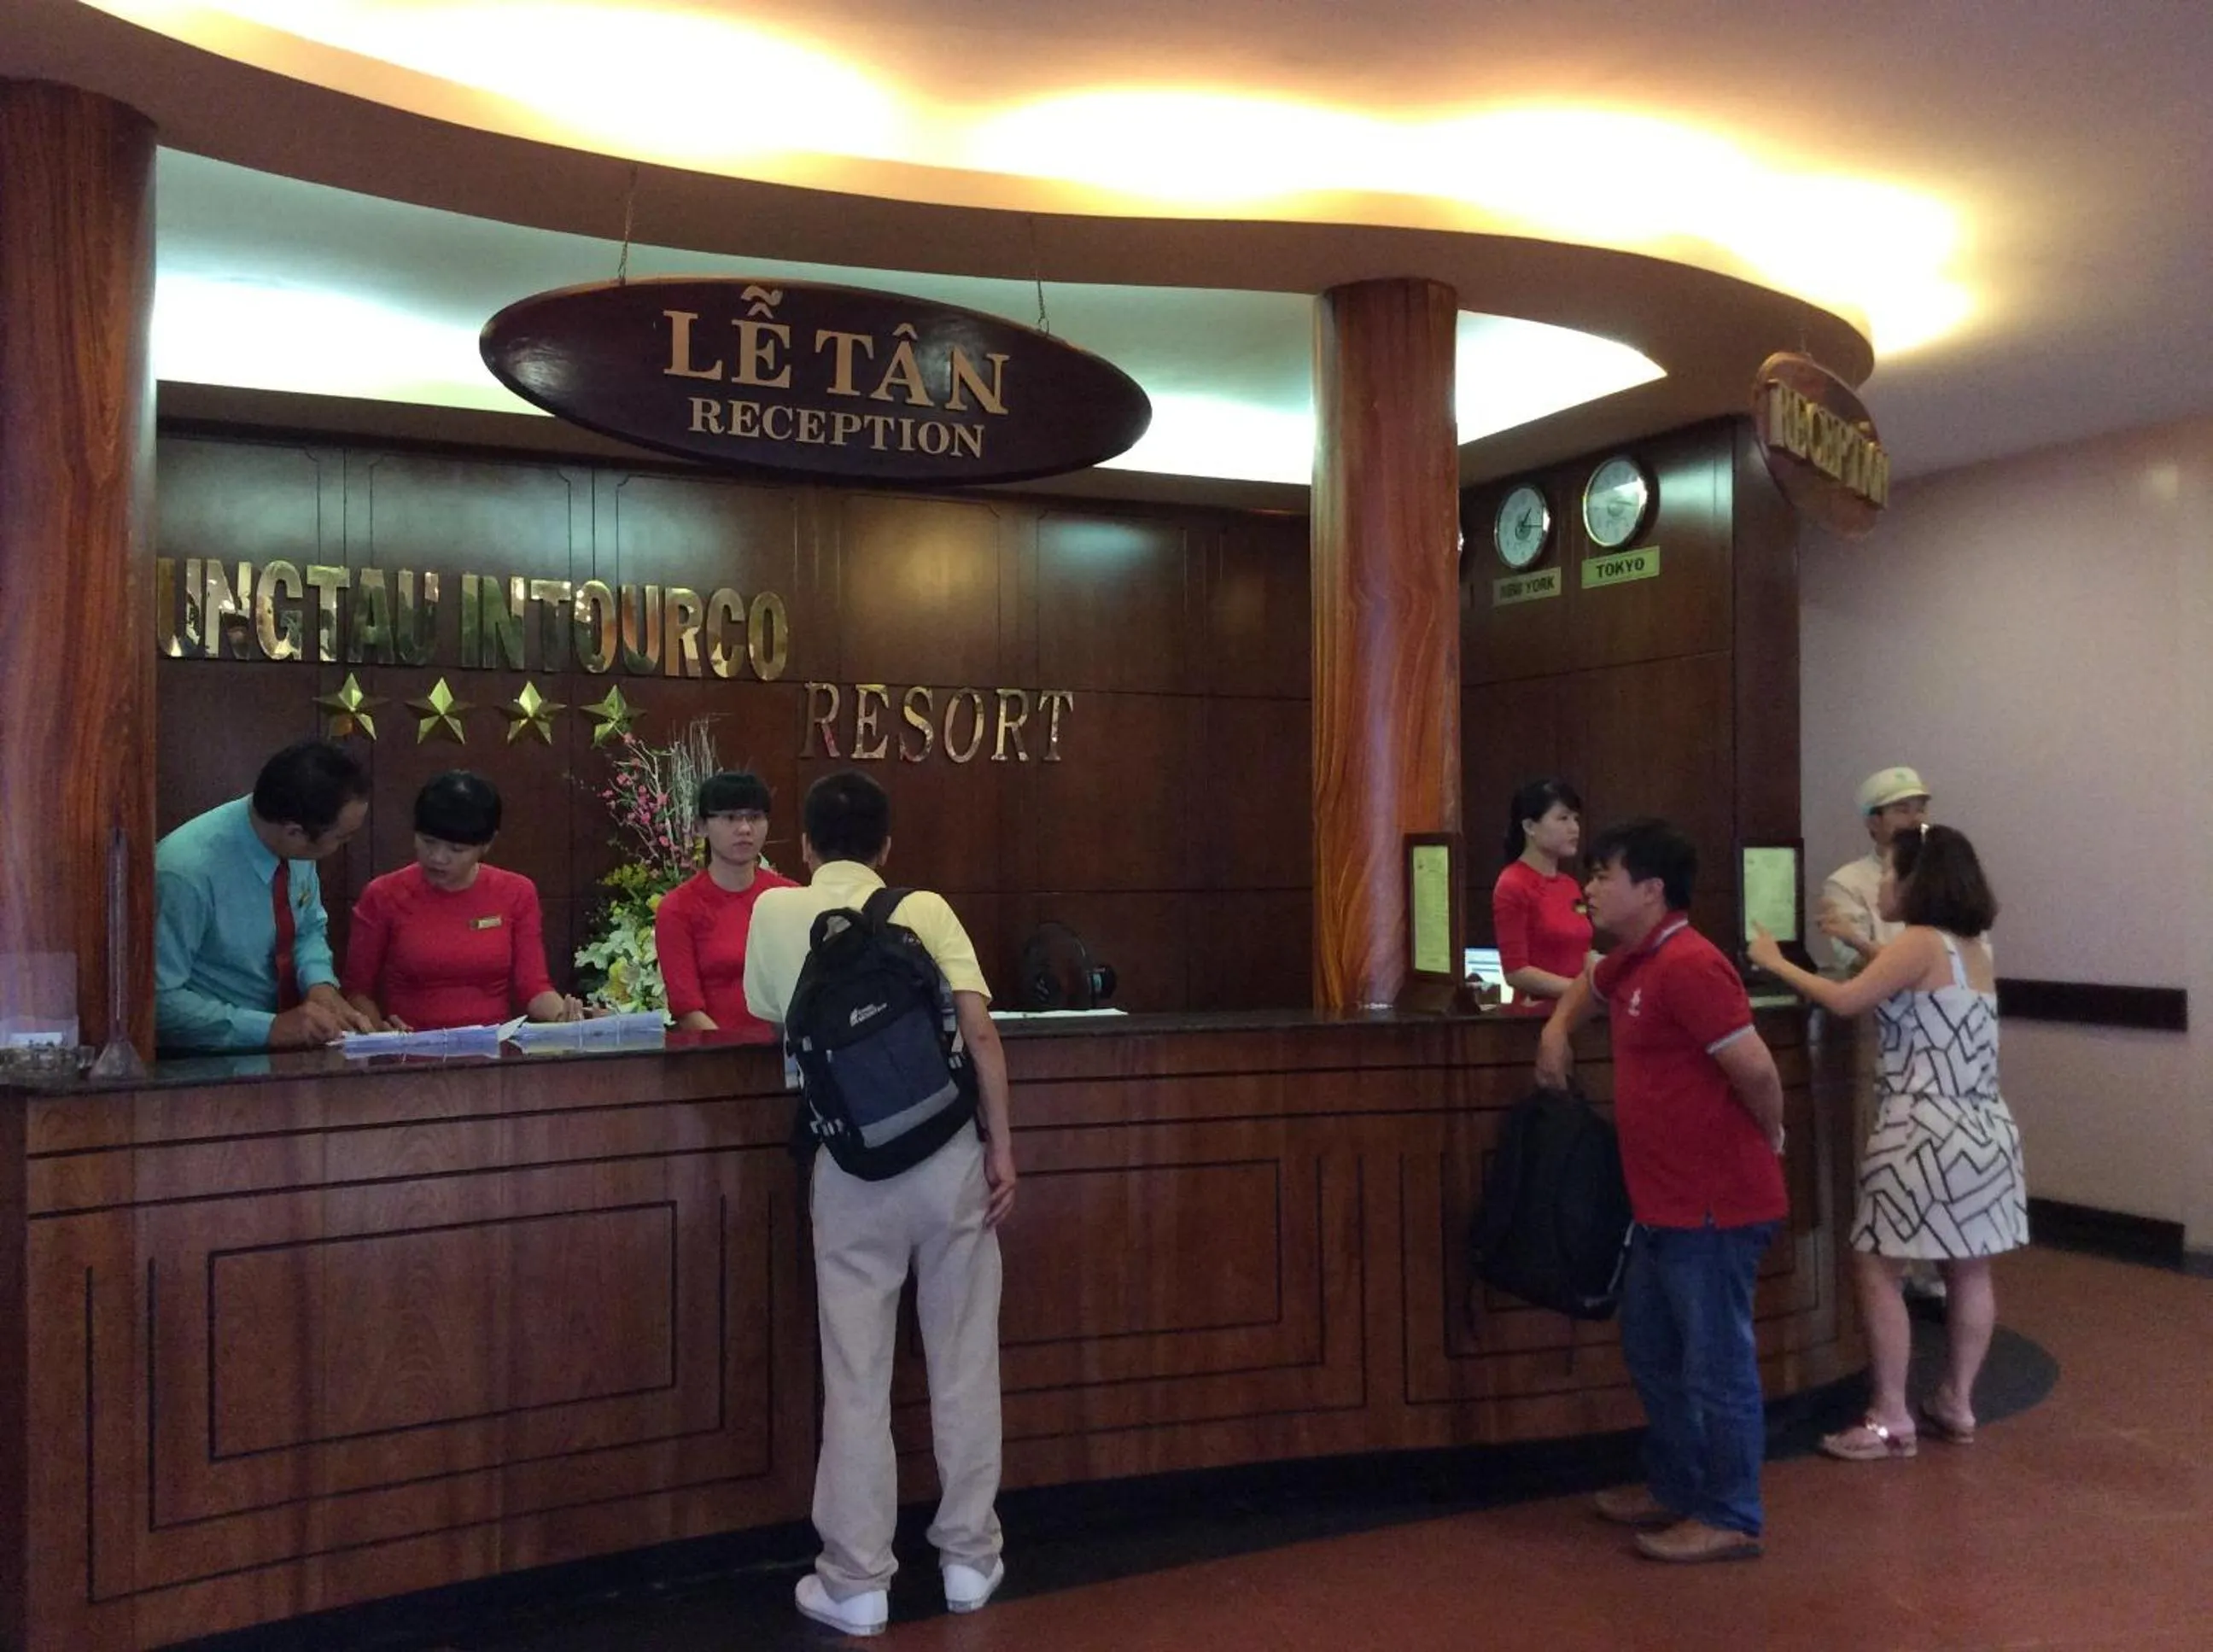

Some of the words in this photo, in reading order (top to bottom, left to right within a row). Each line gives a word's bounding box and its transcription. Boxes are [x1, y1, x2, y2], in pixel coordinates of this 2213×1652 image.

[662, 285, 791, 389] LỄ
[815, 323, 1010, 416] TÂN
[687, 396, 985, 458] RECEPTION
[1525, 575, 1556, 594] YORK
[1597, 557, 1645, 579] TOKYO
[460, 574, 789, 682] INTOURCO
[798, 681, 1074, 764] RESORT
